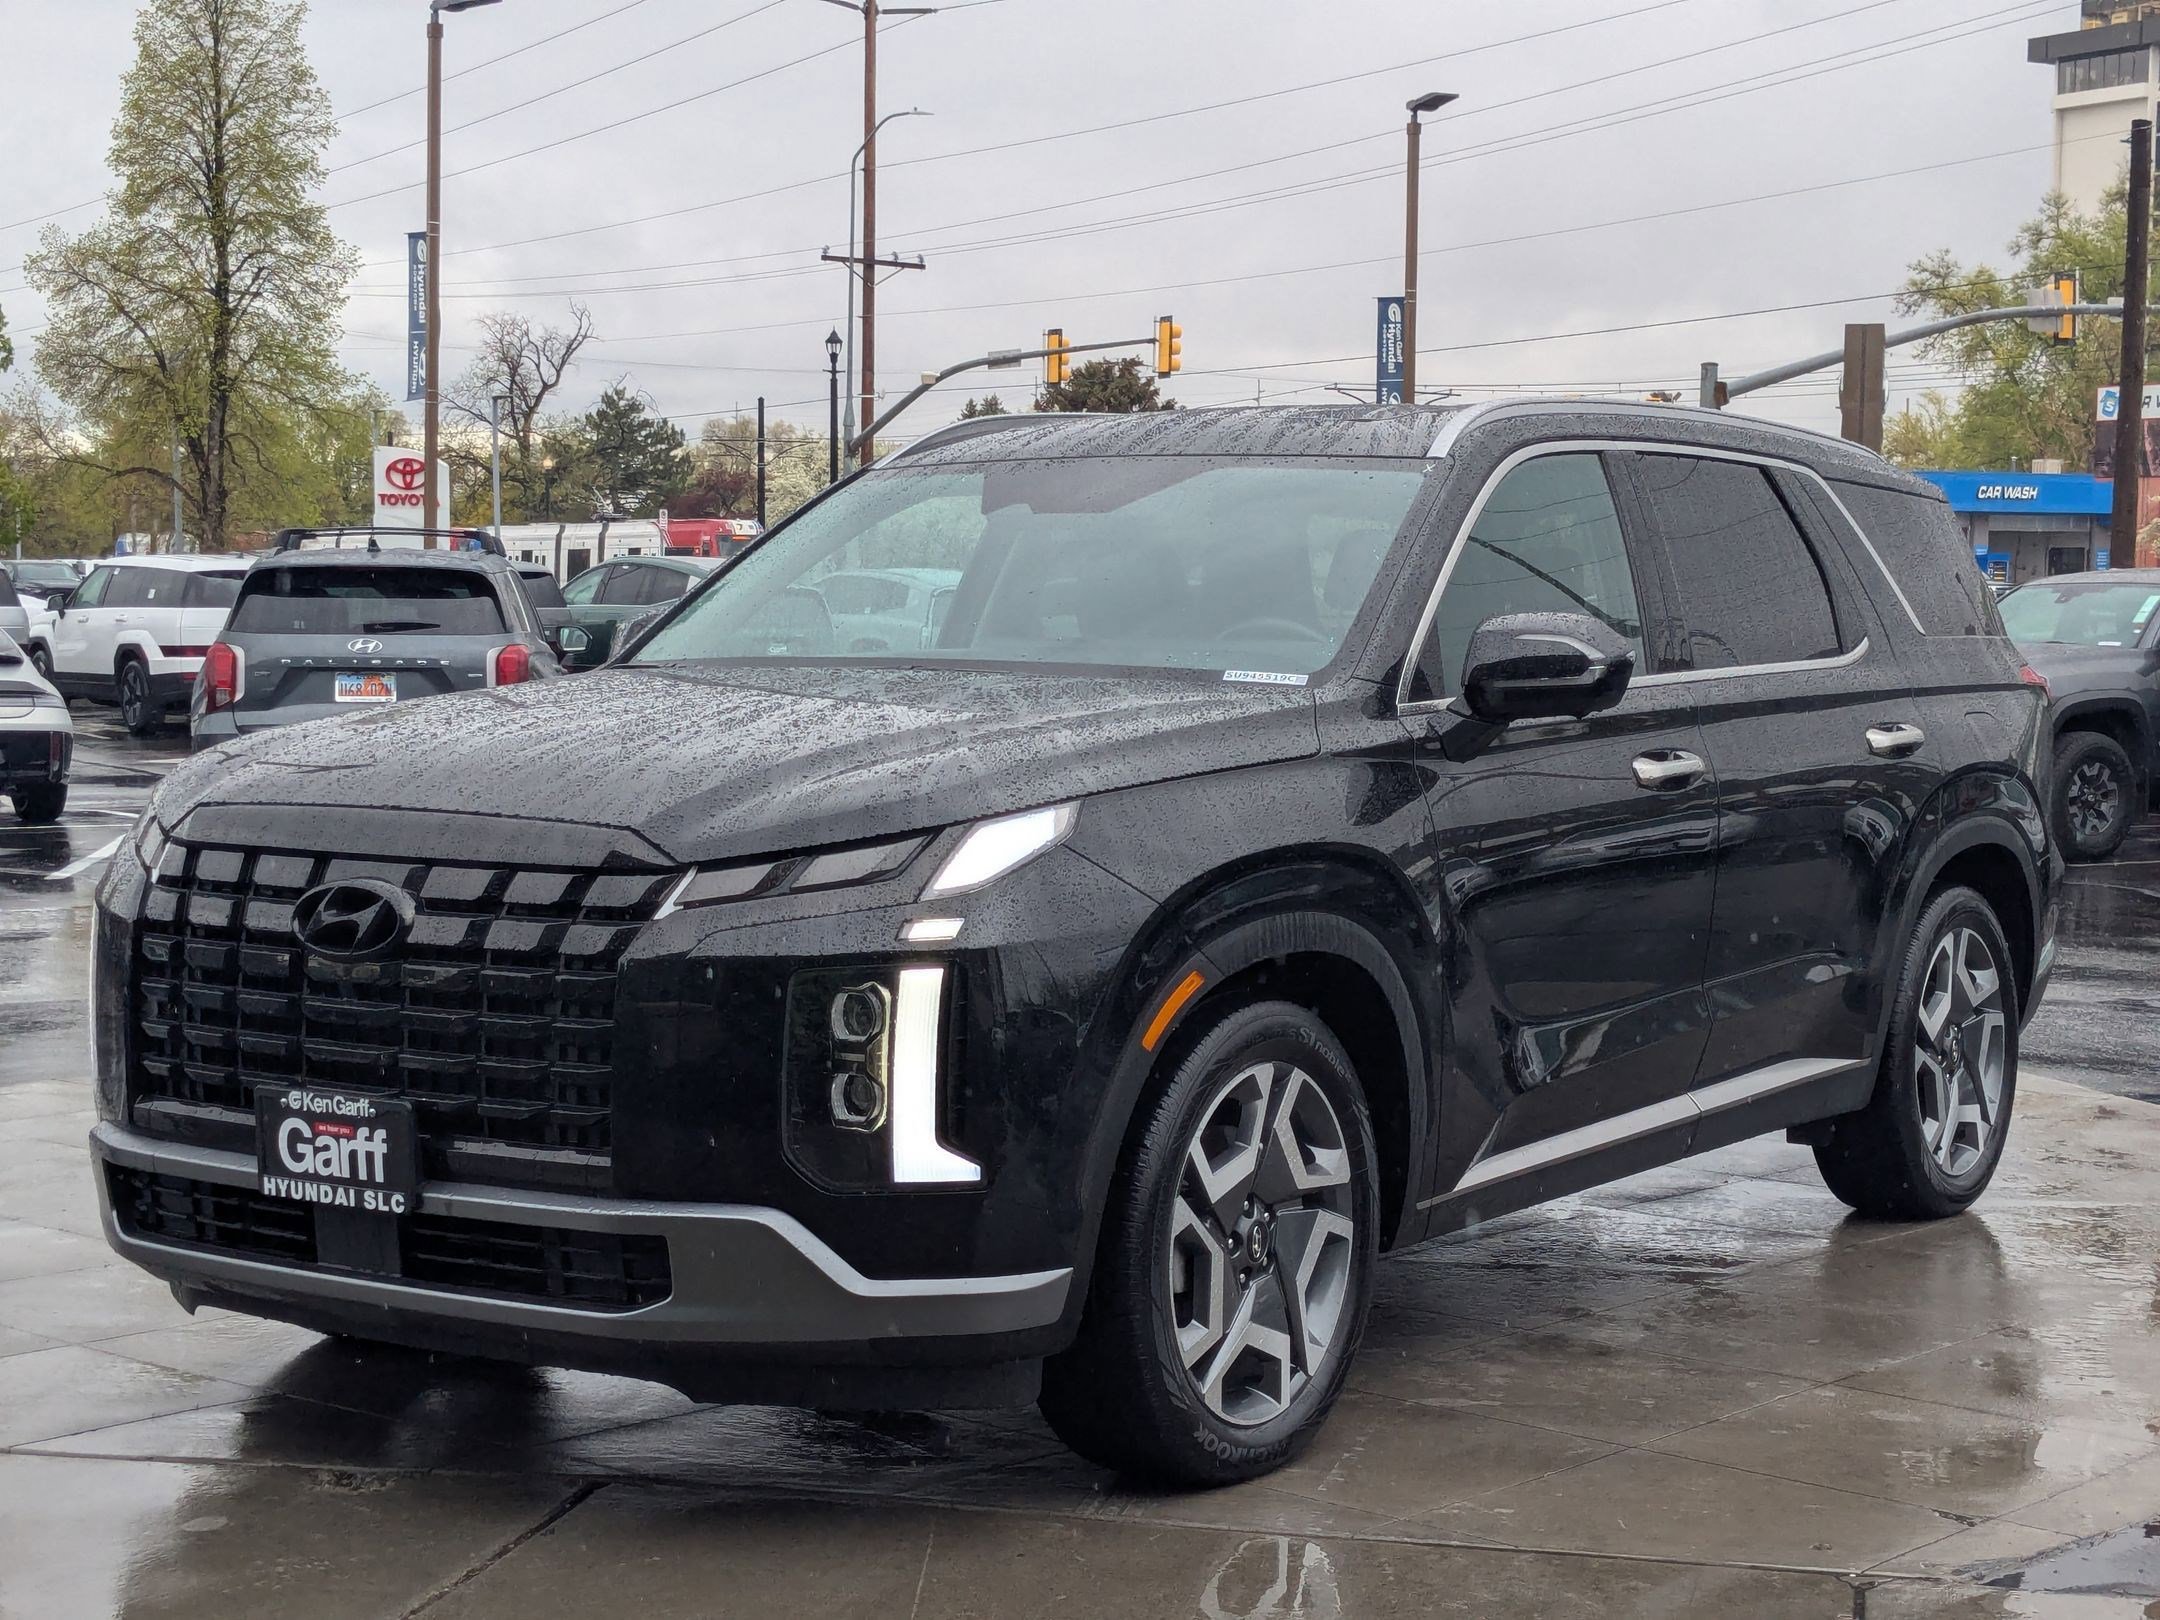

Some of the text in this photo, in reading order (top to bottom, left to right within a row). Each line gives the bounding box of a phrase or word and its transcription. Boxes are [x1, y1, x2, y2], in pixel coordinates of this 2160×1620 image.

[418, 264, 427, 323] Hyundai
[410, 340, 419, 393] HYUNDAI
[1387, 323, 1396, 373] Hyundai
[378, 493, 440, 507] TOYOT
[1978, 485, 2038, 500] CAR WASH
[278, 1117, 387, 1183] Garff
[263, 1176, 405, 1214] HYUNDAI SLC
